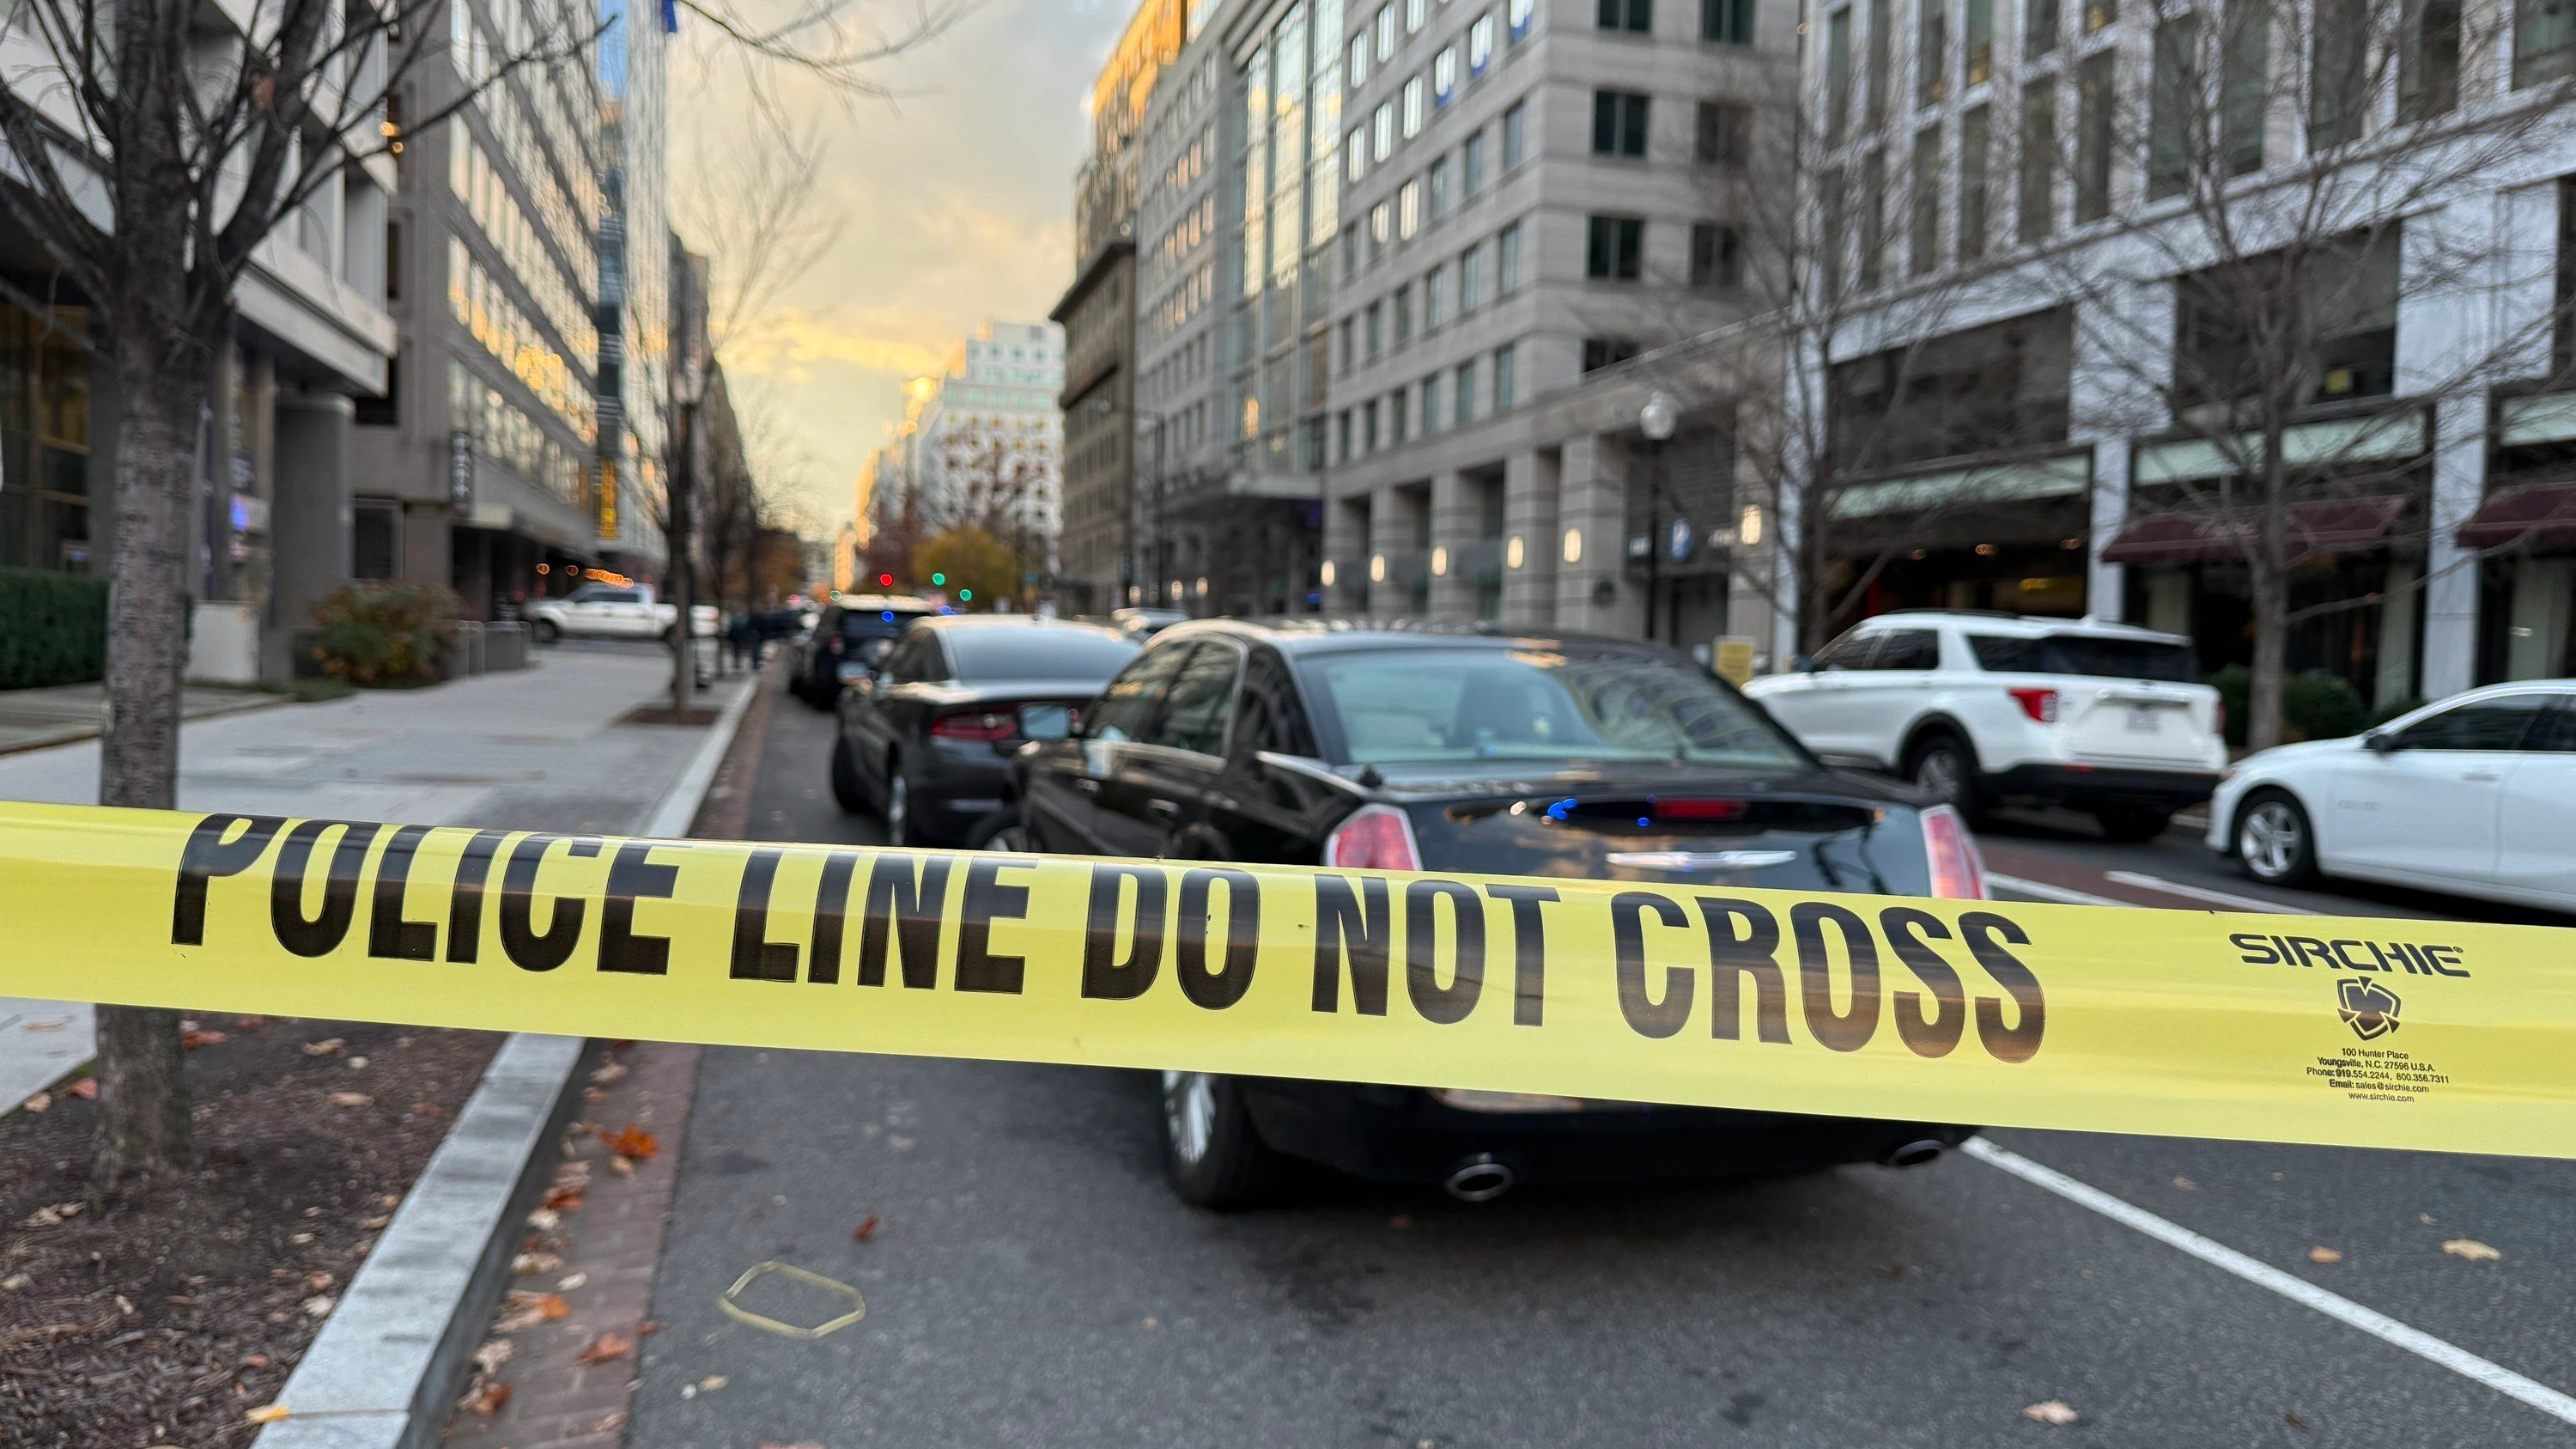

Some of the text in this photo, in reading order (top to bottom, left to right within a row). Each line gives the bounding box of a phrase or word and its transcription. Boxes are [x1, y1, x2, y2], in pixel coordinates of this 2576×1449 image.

[171, 813, 2045, 1063] POLICE LINE DO NOT CROSS
[2342, 1047, 2409, 1059] 100 Hunter Place
[2317, 1056, 2436, 1072] Youngsville, N.C. 27596 U.S.A.
[2306, 1067, 2335, 1076] Phone:
[2396, 1072, 2450, 1083] 800.356.7311
[2329, 1079, 2429, 1093] Email: sales@sirchie.com
[2348, 1092, 2415, 1102] www.sirchie.com
